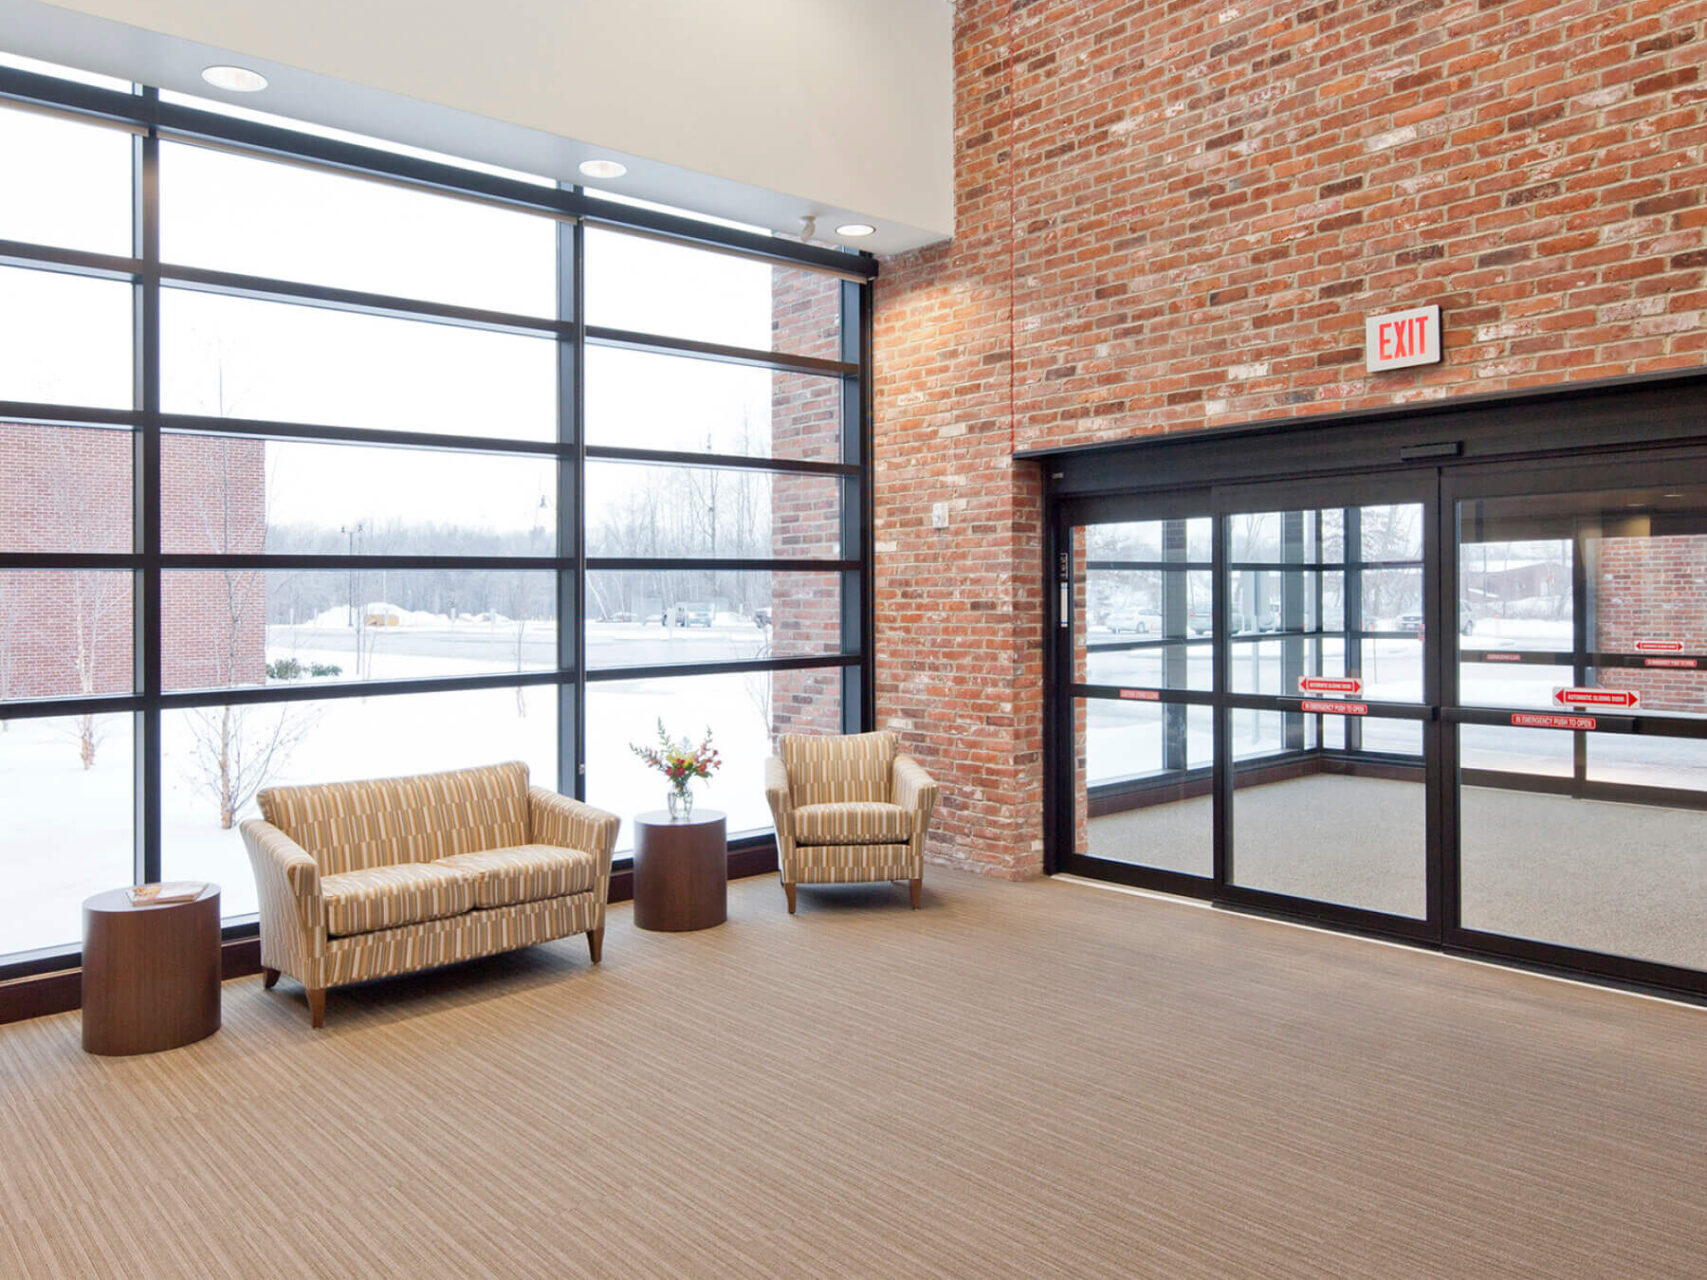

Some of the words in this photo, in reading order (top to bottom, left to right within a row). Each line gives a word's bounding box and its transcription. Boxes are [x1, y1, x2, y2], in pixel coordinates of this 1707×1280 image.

[1379, 315, 1429, 361] EXIT
[1521, 716, 1552, 725] EMERGENCY
[1553, 718, 1568, 726] PUSH
[1577, 719, 1592, 728] OPEN
